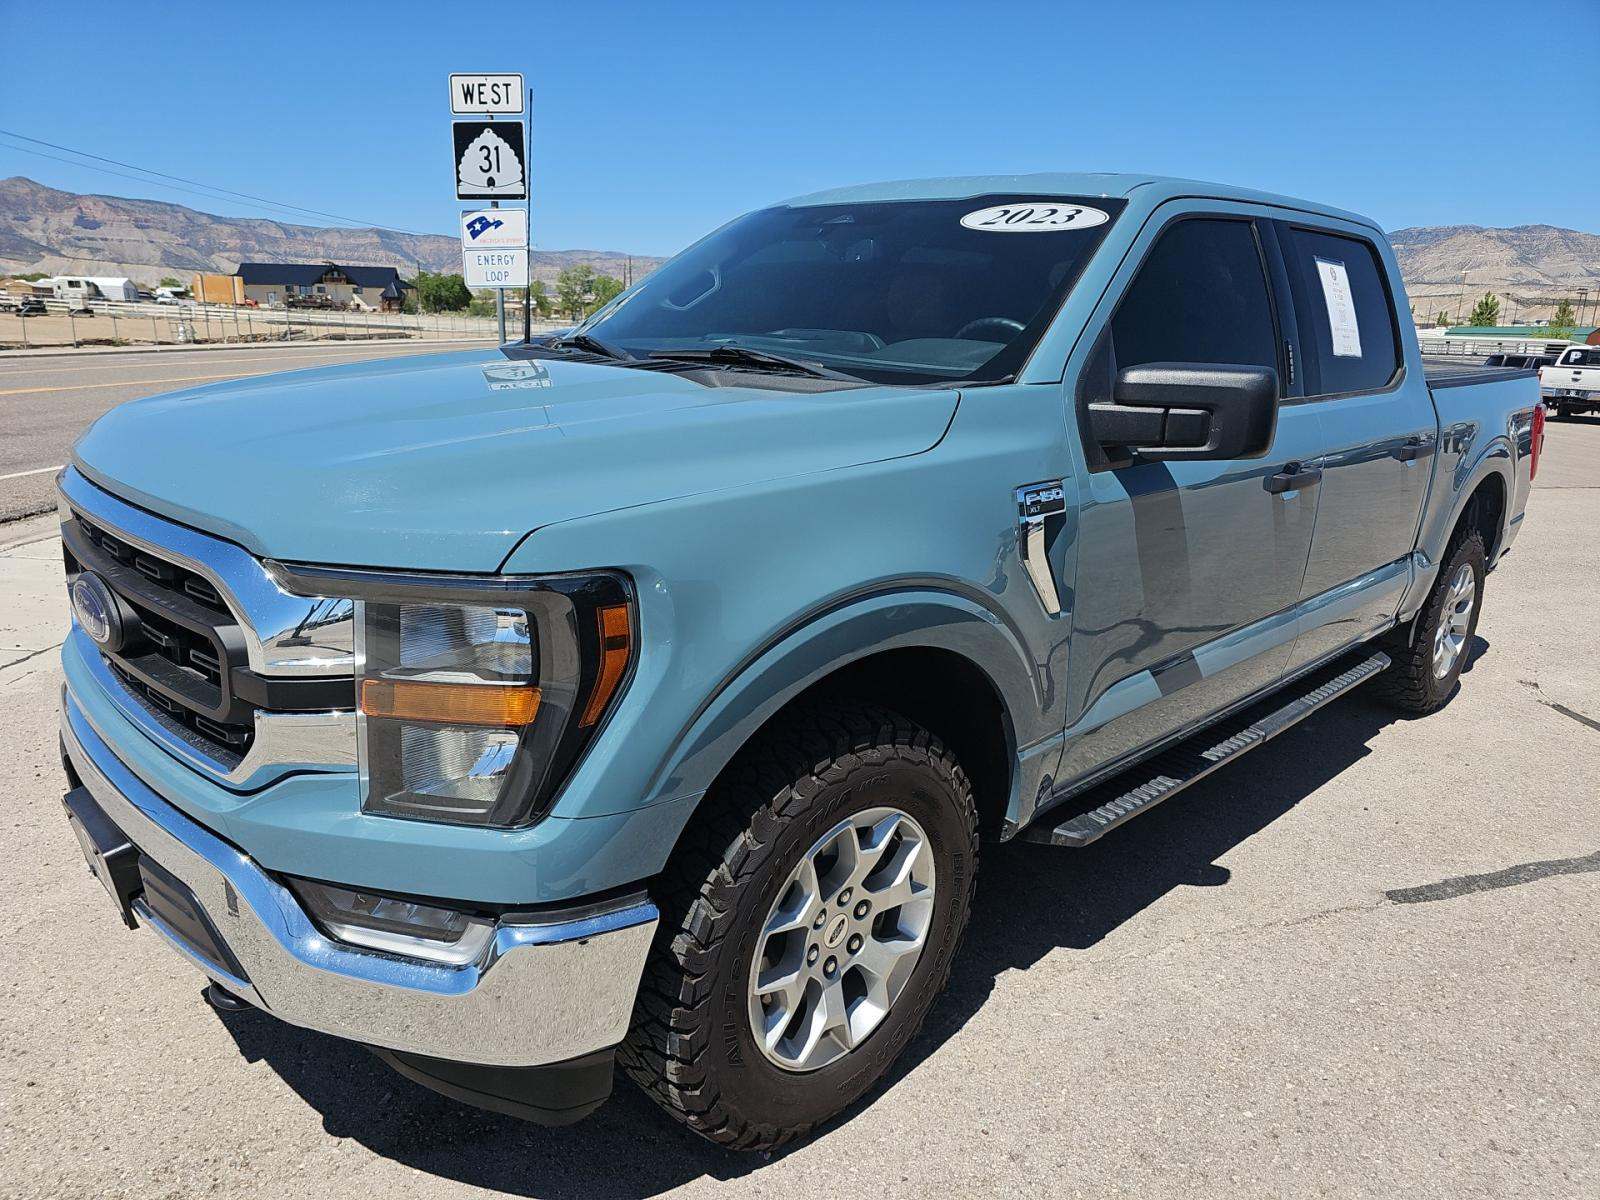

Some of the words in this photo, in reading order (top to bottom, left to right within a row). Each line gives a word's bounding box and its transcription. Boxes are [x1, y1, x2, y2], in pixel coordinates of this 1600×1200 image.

[461, 82, 512, 105] WEST
[478, 144, 501, 174] 31
[978, 207, 1084, 226] 2023
[477, 254, 516, 266] ENERGY
[485, 270, 510, 282] LOOP
[1025, 488, 1064, 506] F-150
